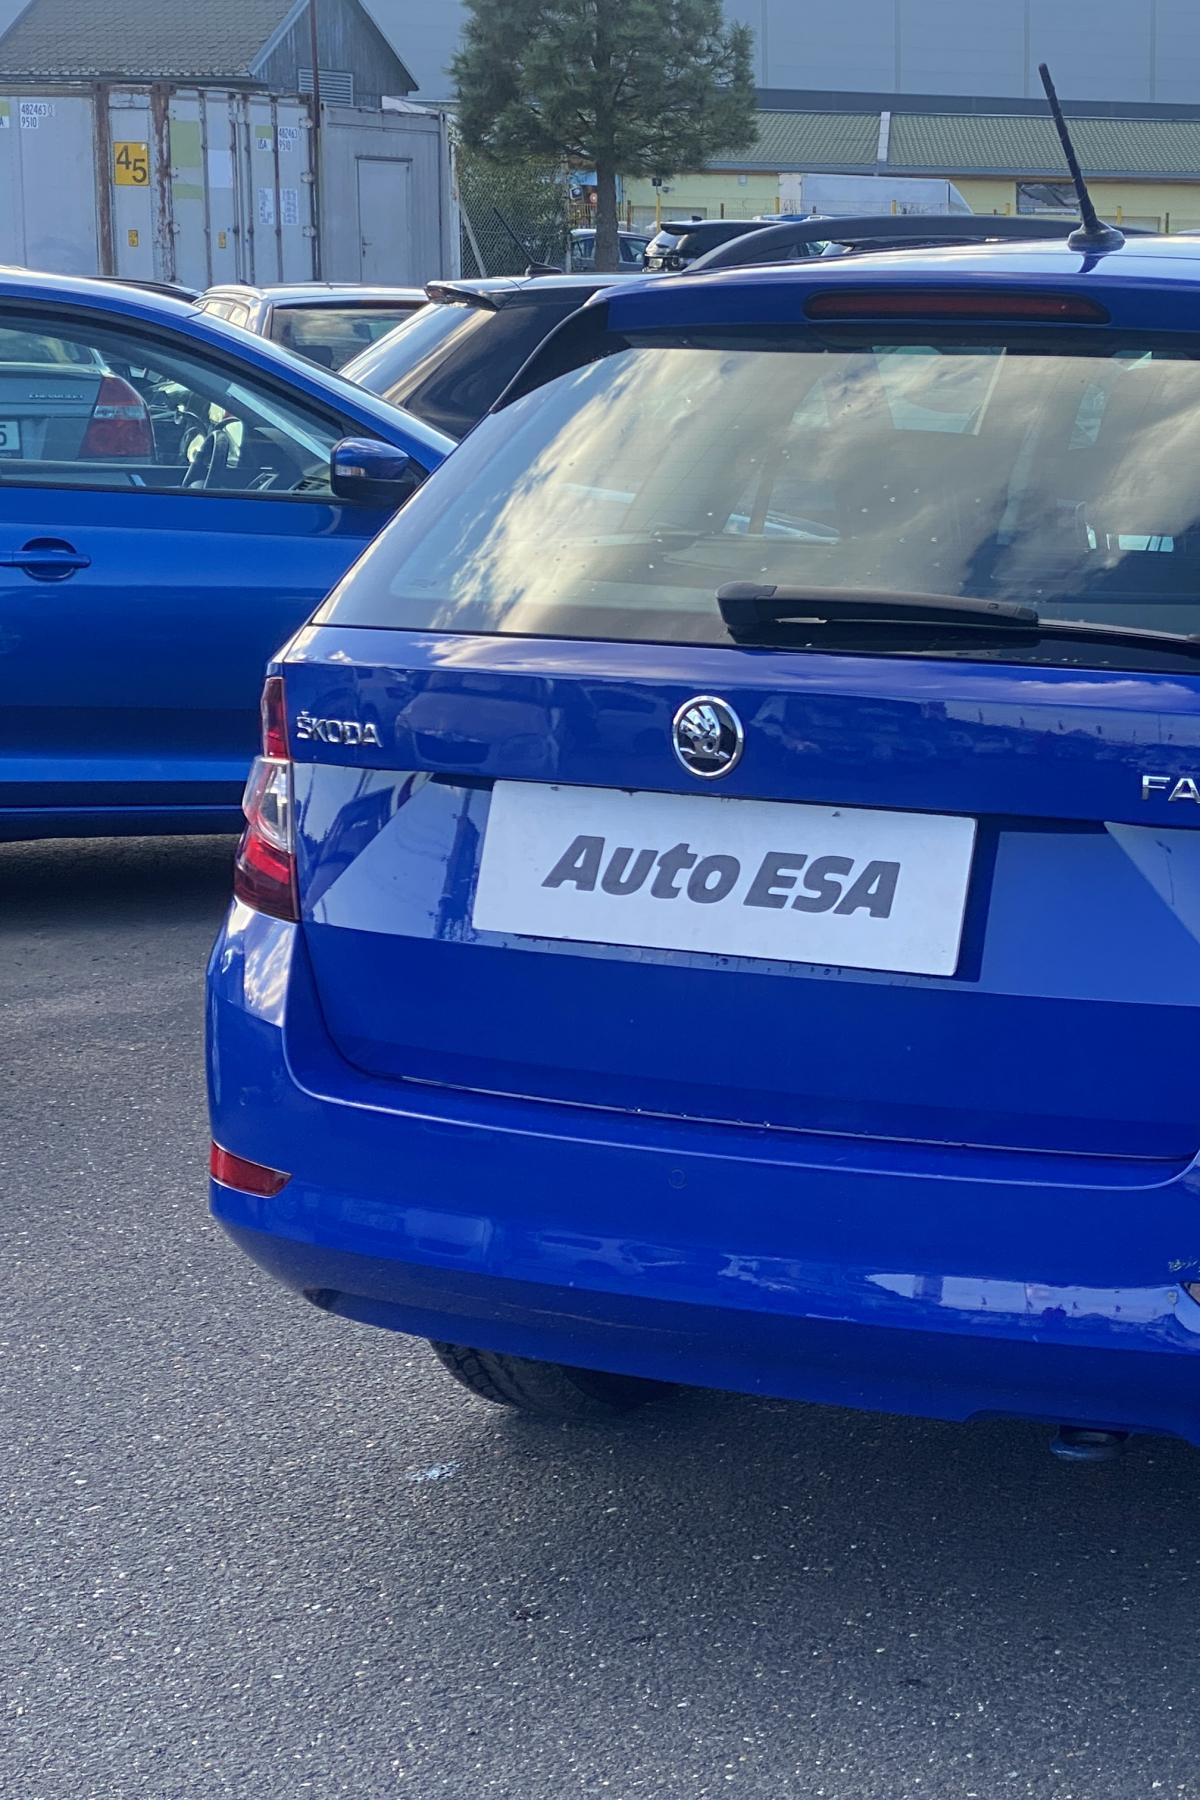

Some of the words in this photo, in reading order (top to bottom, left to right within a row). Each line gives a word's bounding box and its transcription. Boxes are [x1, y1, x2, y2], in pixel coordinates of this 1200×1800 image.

[296, 711, 384, 748] ŠKODA
[541, 834, 741, 905] Auto
[743, 850, 902, 919] ESA
